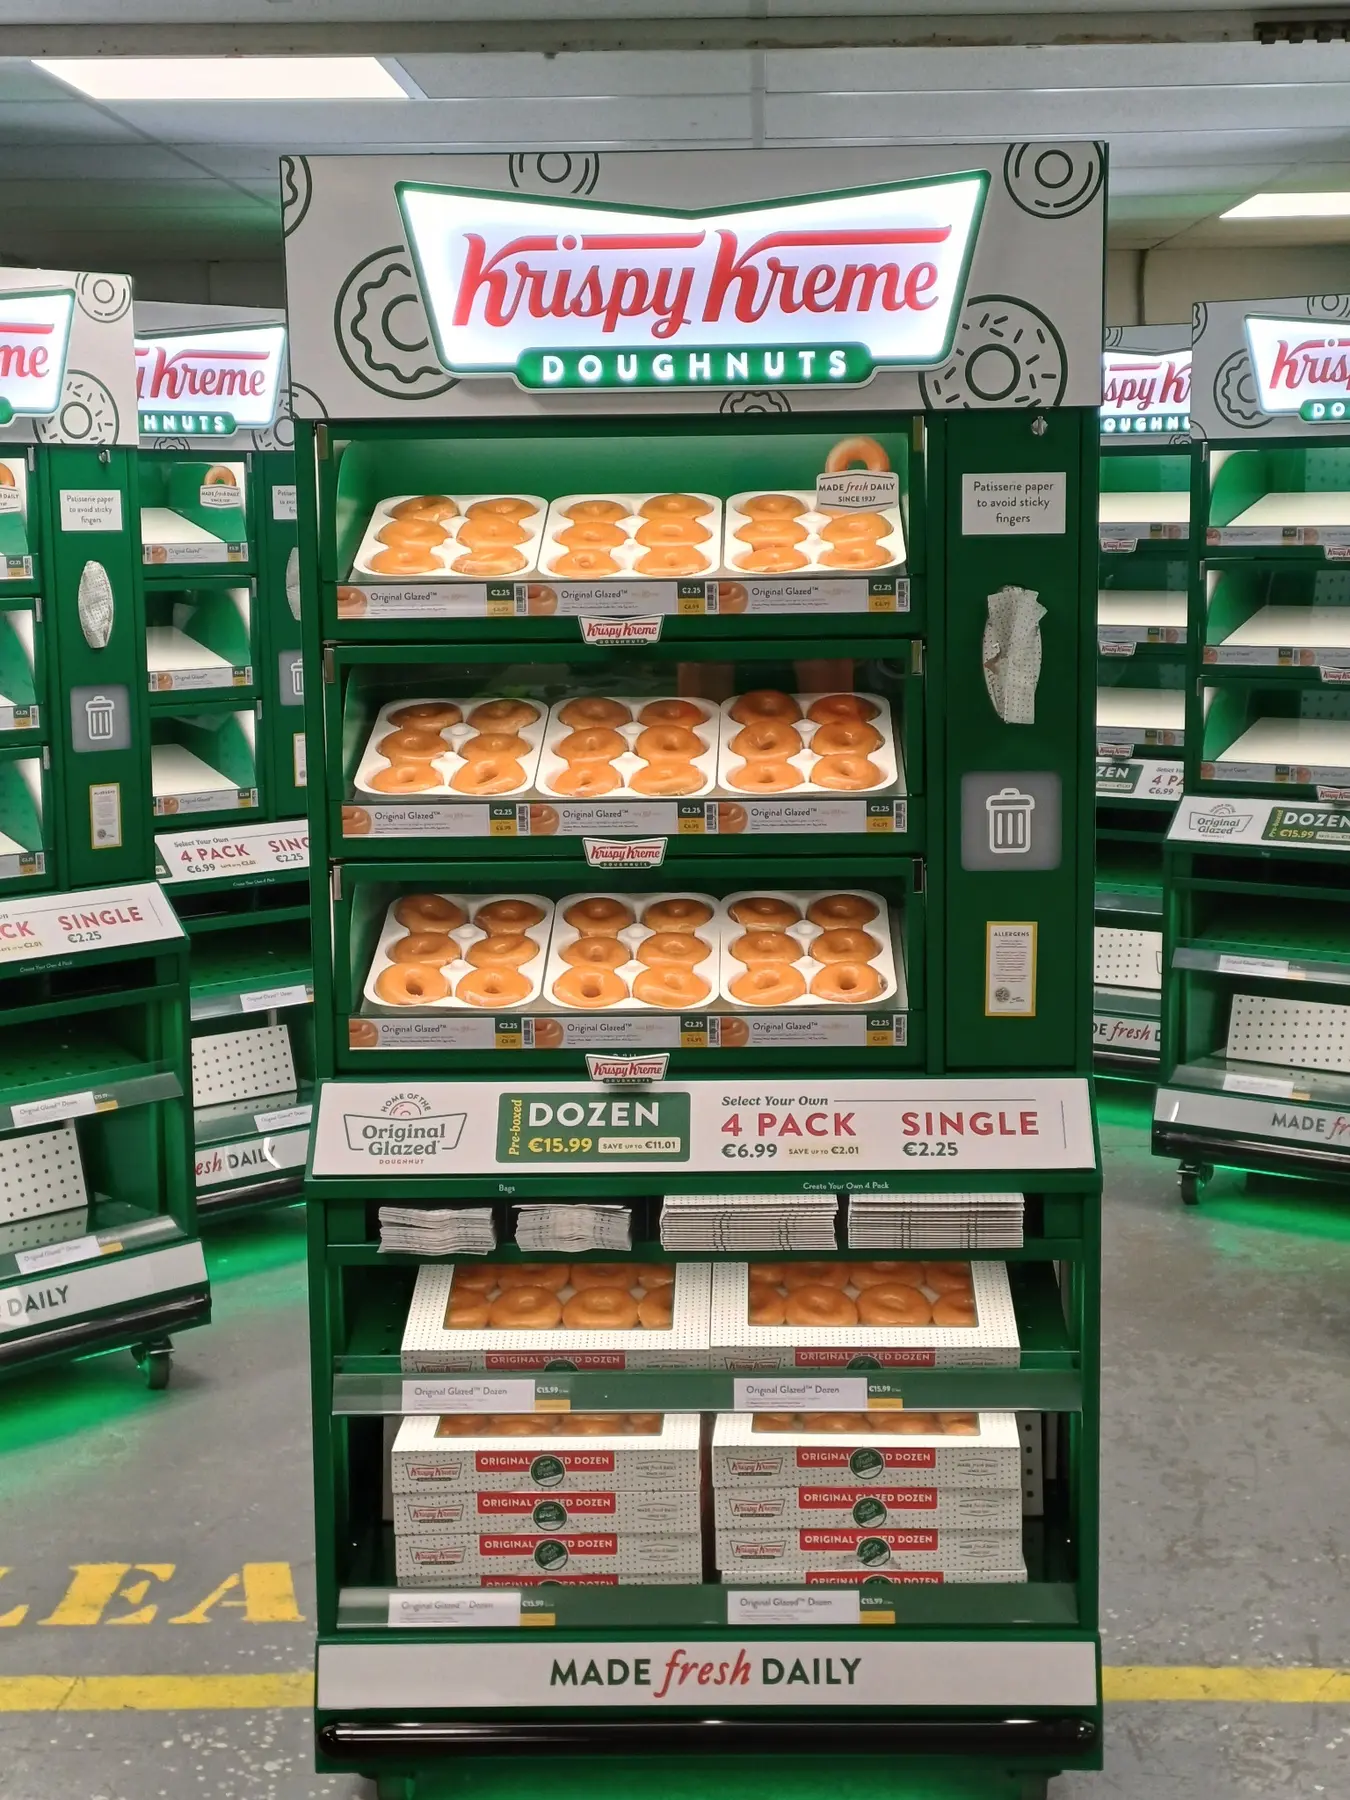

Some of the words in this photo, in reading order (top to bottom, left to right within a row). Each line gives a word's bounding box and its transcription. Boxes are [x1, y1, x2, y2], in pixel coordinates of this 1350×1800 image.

[452, 229, 705, 339] Krispy
[701, 224, 952, 323] Kreme
[541, 349, 848, 384] DOUGHNUTS
[149, 347, 270, 400] Kreme
[819, 483, 844, 492] MADE
[844, 481, 869, 494] fresh
[870, 482, 896, 491] DAILY
[973, 481, 1022, 493] Patisserie
[1025, 482, 1054, 494] paper
[838, 495, 861, 503] SINCE
[977, 498, 988, 508] to
[990, 496, 1018, 508] avoid
[1020, 496, 1050, 510] sticky
[995, 513, 1031, 526] fingers
[490, 588, 511, 597] €2.25
[561, 590, 593, 601] Original
[682, 586, 701, 594] €2.25
[751, 587, 784, 599] Original
[370, 591, 402, 604] Original
[587, 623, 624, 638] Krispy
[622, 622, 658, 637] Kreme
[374, 811, 406, 823] Original
[493, 808, 513, 816] €2.25
[562, 809, 594, 820] Original
[751, 807, 783, 819] Original
[1197, 816, 1241, 828] Original
[1280, 829, 1315, 839] €15.99
[180, 850, 192, 863] 4
[196, 843, 251, 861] PACK
[590, 845, 627, 861] Krispy
[626, 845, 662, 860] Kreme
[58, 906, 143, 931] SINGLE
[67, 931, 102, 943] €2.25
[567, 1023, 598, 1034] Original
[752, 1021, 784, 1033] Original
[870, 1019, 890, 1027] €2.25
[381, 1024, 413, 1036] Original
[1107, 1021, 1152, 1042] fresh
[593, 1062, 630, 1077] Krispy
[628, 1062, 664, 1075] Kreme
[381, 1093, 404, 1113] HOME
[407, 1092, 420, 1100] OF
[418, 1096, 431, 1112] THE
[722, 1095, 762, 1107] Select
[765, 1095, 796, 1107] Your
[798, 1095, 829, 1107] Own
[528, 1101, 659, 1128] DOZEN
[508, 1098, 524, 1157] Pre-boxed
[721, 1113, 742, 1137] 4
[758, 1112, 857, 1137] PACK
[901, 1111, 1039, 1136] SINGLE
[1271, 1112, 1327, 1133] MADE
[362, 1123, 446, 1143] Original
[527, 1137, 593, 1153] €15.99
[602, 1142, 624, 1150] SAVE
[645, 1141, 676, 1149] €11.01
[722, 1143, 778, 1158] €6.99
[831, 1146, 860, 1155] €2.01
[902, 1141, 959, 1157] €2.25
[227, 1144, 276, 1169] DAILY
[498, 1184, 516, 1194] Bags
[803, 1181, 827, 1190] Create
[828, 1181, 845, 1190] Your
[846, 1181, 864, 1190] Own
[865, 1181, 871, 1189] 4
[872, 1180, 889, 1189] Pack
[7, 1285, 68, 1317] DAILY
[491, 1356, 540, 1364] ORIGINAL
[585, 1356, 620, 1364] DOZEN
[800, 1352, 850, 1361] ORIGINAL
[894, 1352, 930, 1361] DOZEN
[414, 1387, 446, 1398] Original
[483, 1386, 508, 1396] Dozen
[536, 1386, 559, 1394] €15.99
[746, 1385, 778, 1397] Original
[815, 1385, 840, 1394] Dozen
[868, 1385, 890, 1393] €15.99
[480, 1456, 530, 1465] ORIGINAL
[574, 1456, 610, 1465] DOZEN
[895, 1452, 931, 1461] DOZEN
[482, 1498, 532, 1507] ORIGINAL
[576, 1498, 611, 1507] DOZEN
[803, 1493, 853, 1502] ORIGINAL
[897, 1493, 933, 1502] DOZEN
[484, 1540, 533, 1549] ORIGINAL
[577, 1540, 613, 1548] DOZEN
[804, 1535, 854, 1544] ORIGINAL
[898, 1535, 933, 1544] DOZEN
[401, 1600, 433, 1612] Original
[740, 1597, 771, 1609] Original
[550, 1658, 651, 1686] MADE
[653, 1648, 752, 1699] fresh
[762, 1657, 862, 1685] DAILY
